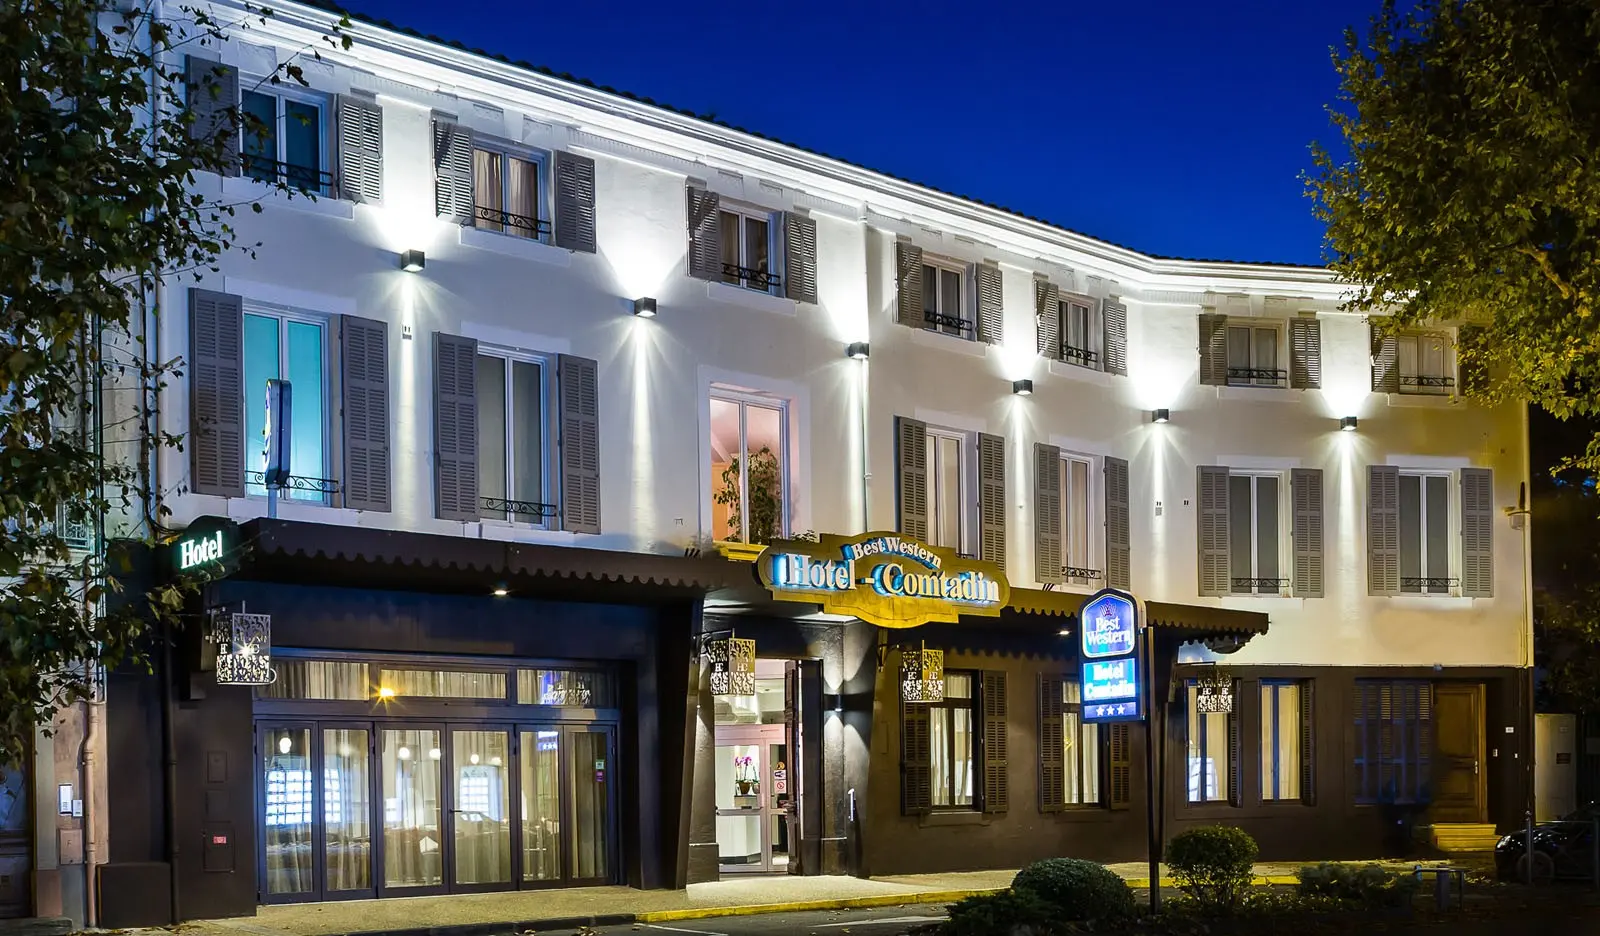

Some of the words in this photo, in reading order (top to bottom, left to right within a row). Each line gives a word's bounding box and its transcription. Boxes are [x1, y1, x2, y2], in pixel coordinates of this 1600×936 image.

[180, 530, 223, 570] Hotel
[851, 538, 886, 561] Best
[886, 536, 942, 570] Western
[786, 553, 857, 590] Hotel
[882, 563, 1000, 602] Comtadin
[1086, 630, 1132, 646] Western
[1096, 616, 1121, 631] Best
